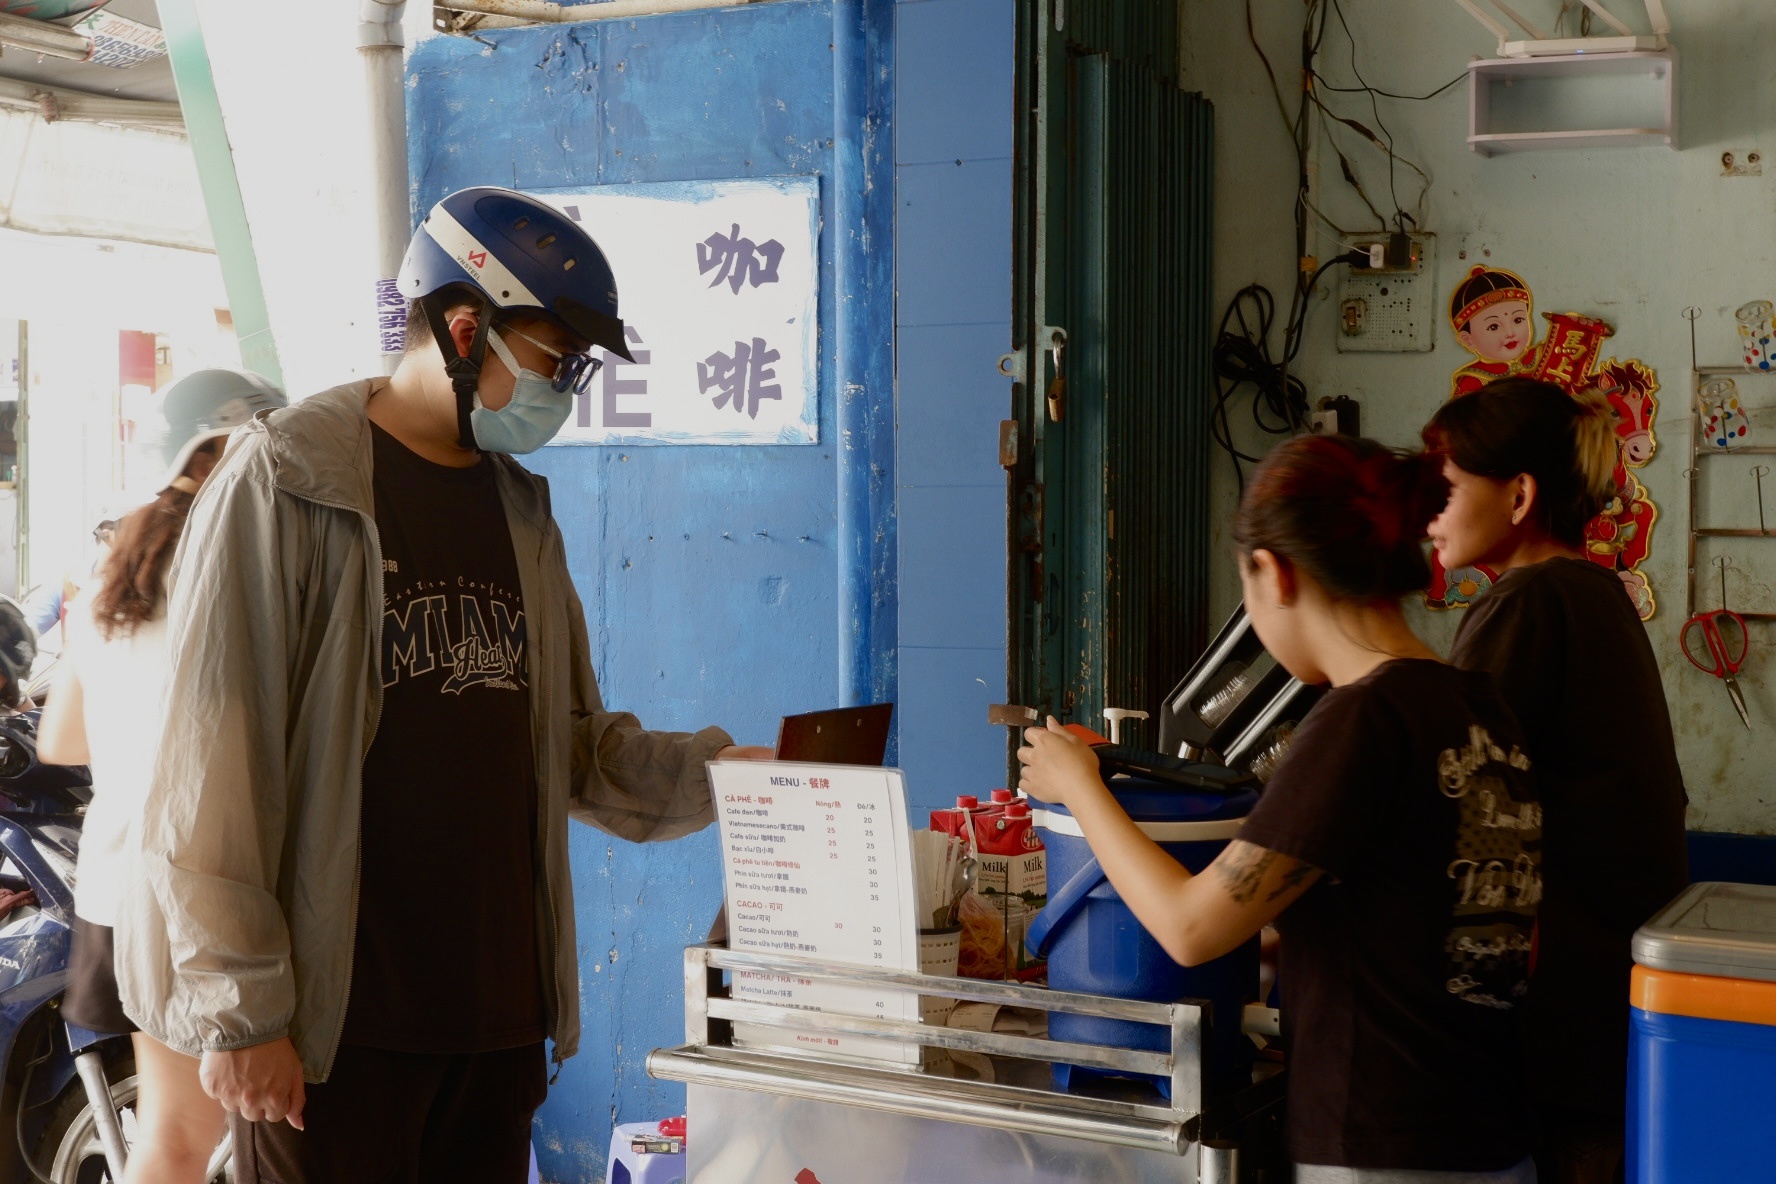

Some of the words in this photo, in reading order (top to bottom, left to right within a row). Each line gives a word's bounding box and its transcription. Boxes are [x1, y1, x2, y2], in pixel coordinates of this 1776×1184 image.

[696, 223, 785, 420] 咖啡
[1544, 330, 1587, 387] 馬上
[769, 776, 800, 787] MENU
[724, 795, 736, 803] CÀ
[737, 795, 752, 804] PHÊ
[982, 861, 1007, 873] Milk
[1023, 856, 1043, 873] Milk
[737, 900, 763, 909] CACAO
[769, 902, 783, 911] 可可
[738, 926, 757, 934] Cacao
[739, 938, 758, 947] Cacao
[740, 971, 775, 982] MATCHA/
[740, 986, 762, 995] Matcha
